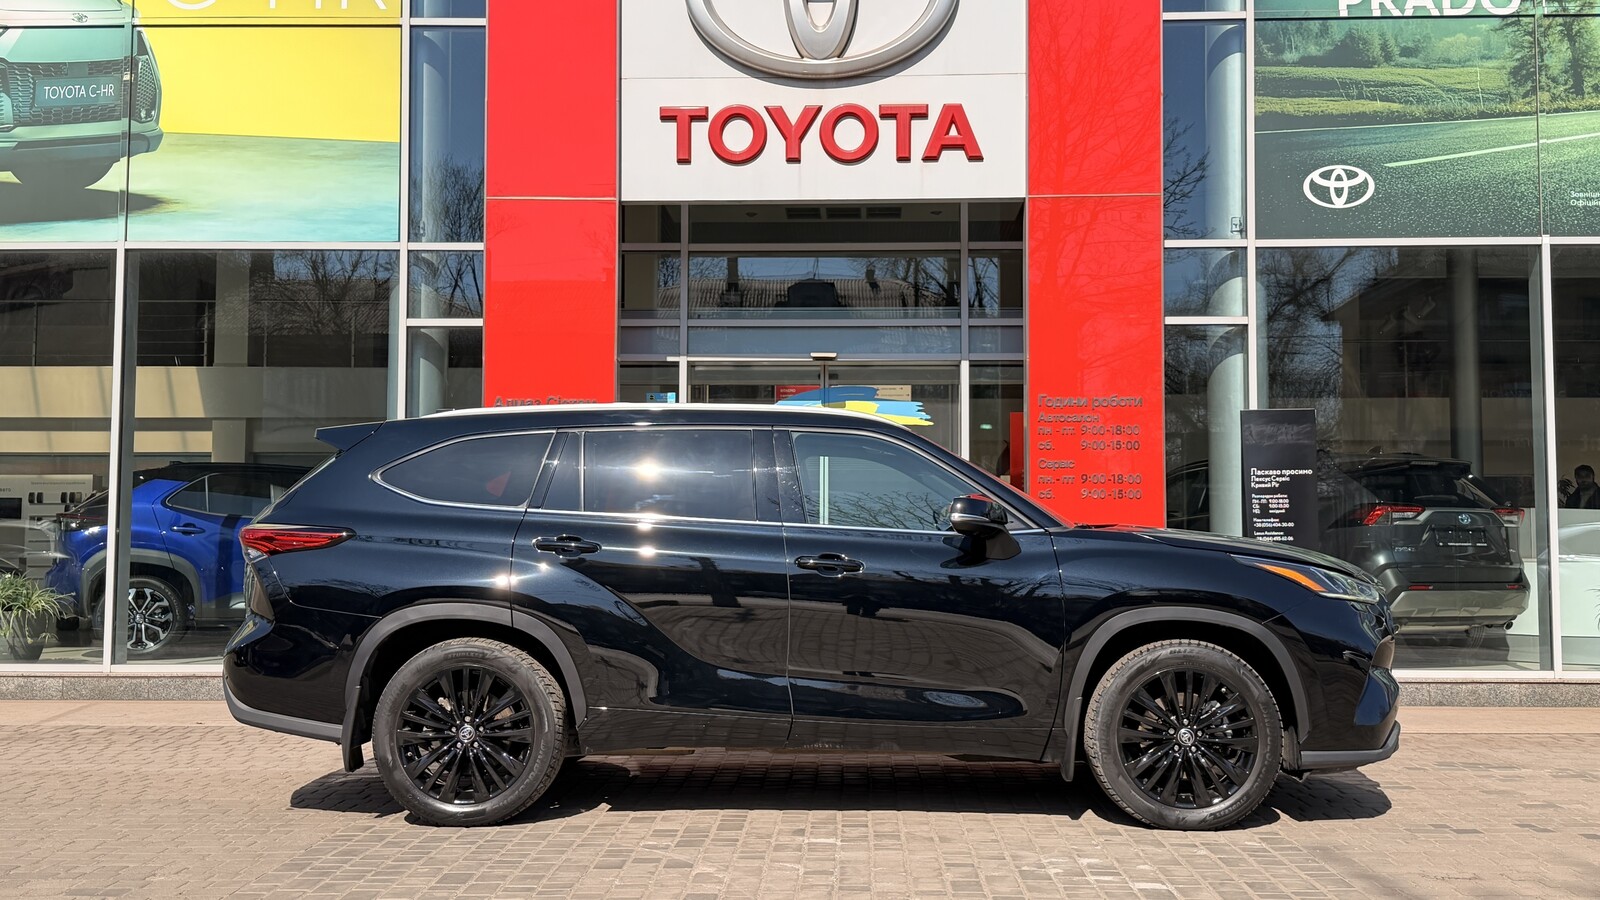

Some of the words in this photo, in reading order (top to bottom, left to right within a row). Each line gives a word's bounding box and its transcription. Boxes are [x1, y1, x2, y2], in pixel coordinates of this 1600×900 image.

[43, 85, 87, 99] TOYOTA
[88, 84, 115, 97] C-HR
[660, 103, 984, 165] TOYOTA
[1038, 394, 1088, 410] Години
[1091, 394, 1143, 411] роботи
[1037, 412, 1100, 423] Автосалон
[1080, 425, 1141, 436] 9:00-18:00
[1080, 440, 1141, 451] 9:00-15:00
[1037, 458, 1076, 472] Сервіс
